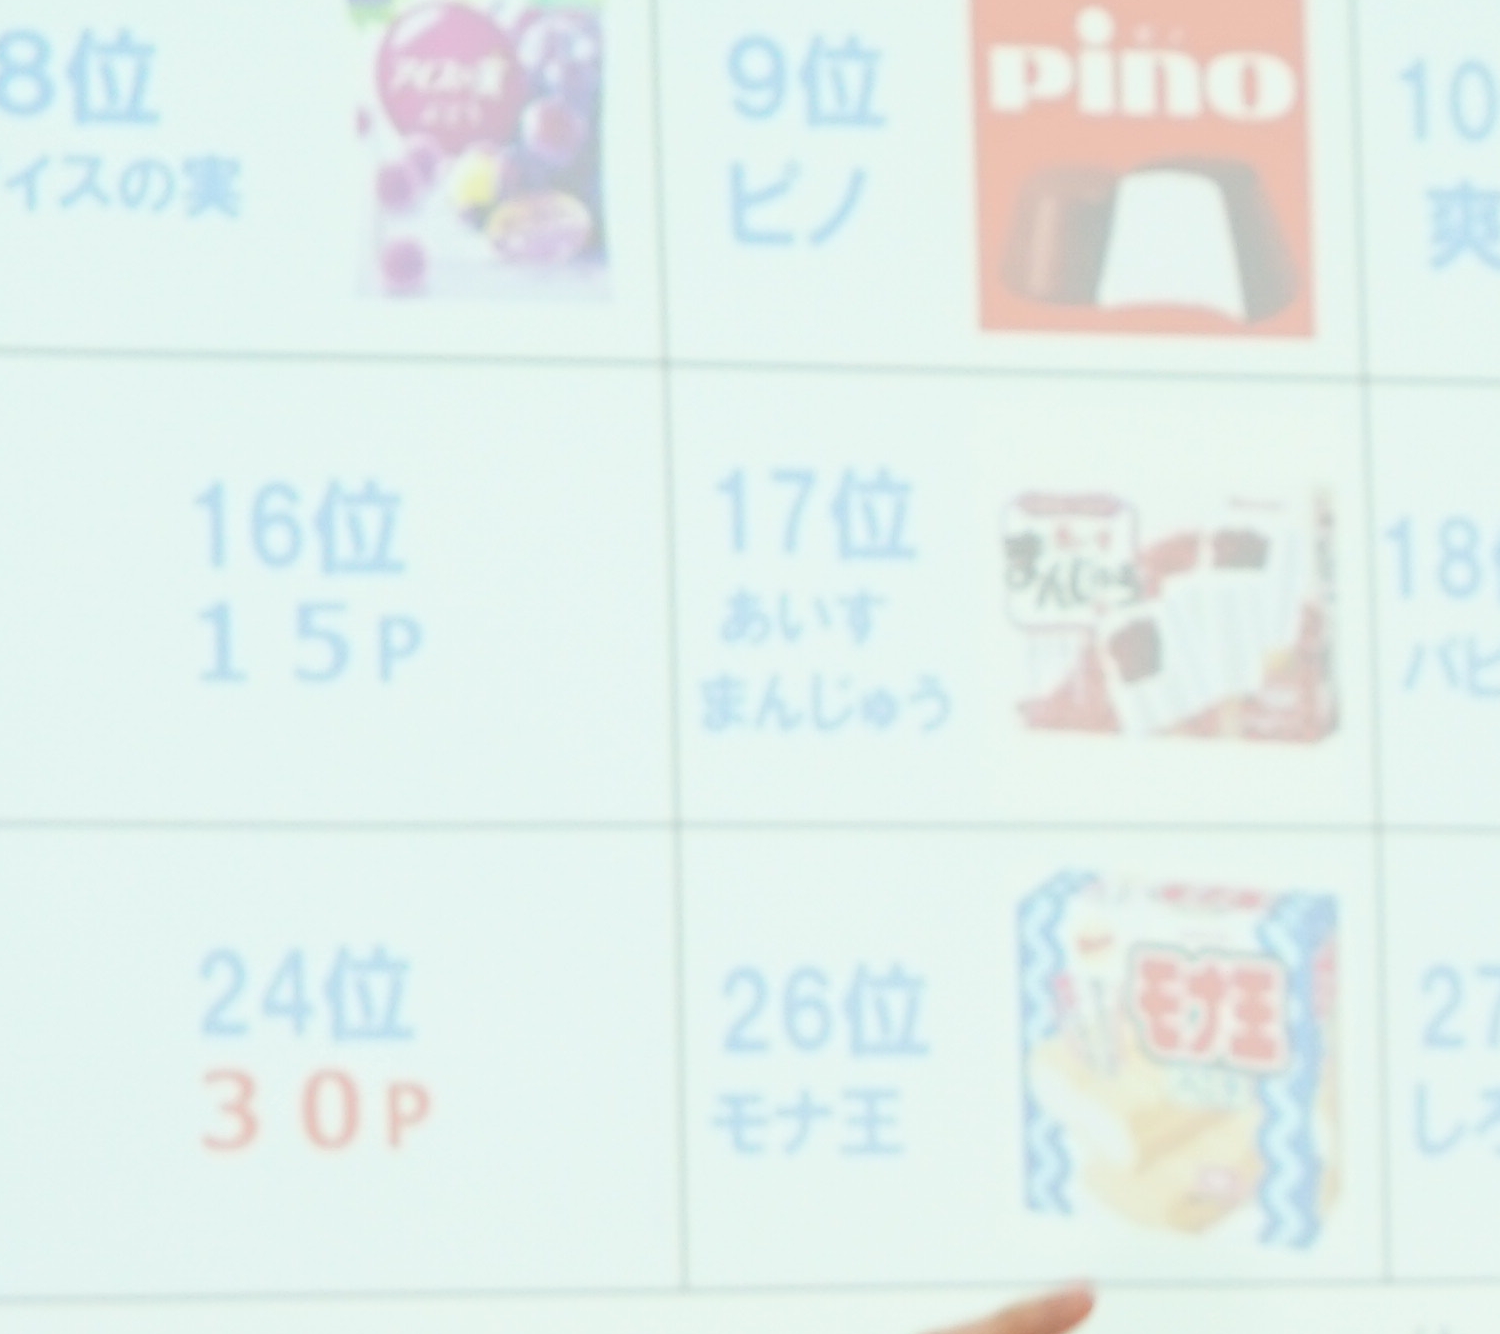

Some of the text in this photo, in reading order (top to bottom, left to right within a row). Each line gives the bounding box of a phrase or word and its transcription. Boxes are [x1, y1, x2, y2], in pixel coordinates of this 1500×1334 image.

[728, 32, 887, 128] 9位
[986, 5, 1297, 122] pino
[193, 478, 406, 576] 16位
[716, 466, 918, 562] 17位
[718, 587, 888, 646] あいす
[700, 671, 953, 734] まんじゅう
[198, 946, 416, 1043] 24位
[720, 962, 931, 1058] 26位
[712, 1087, 904, 1157] モナ王
